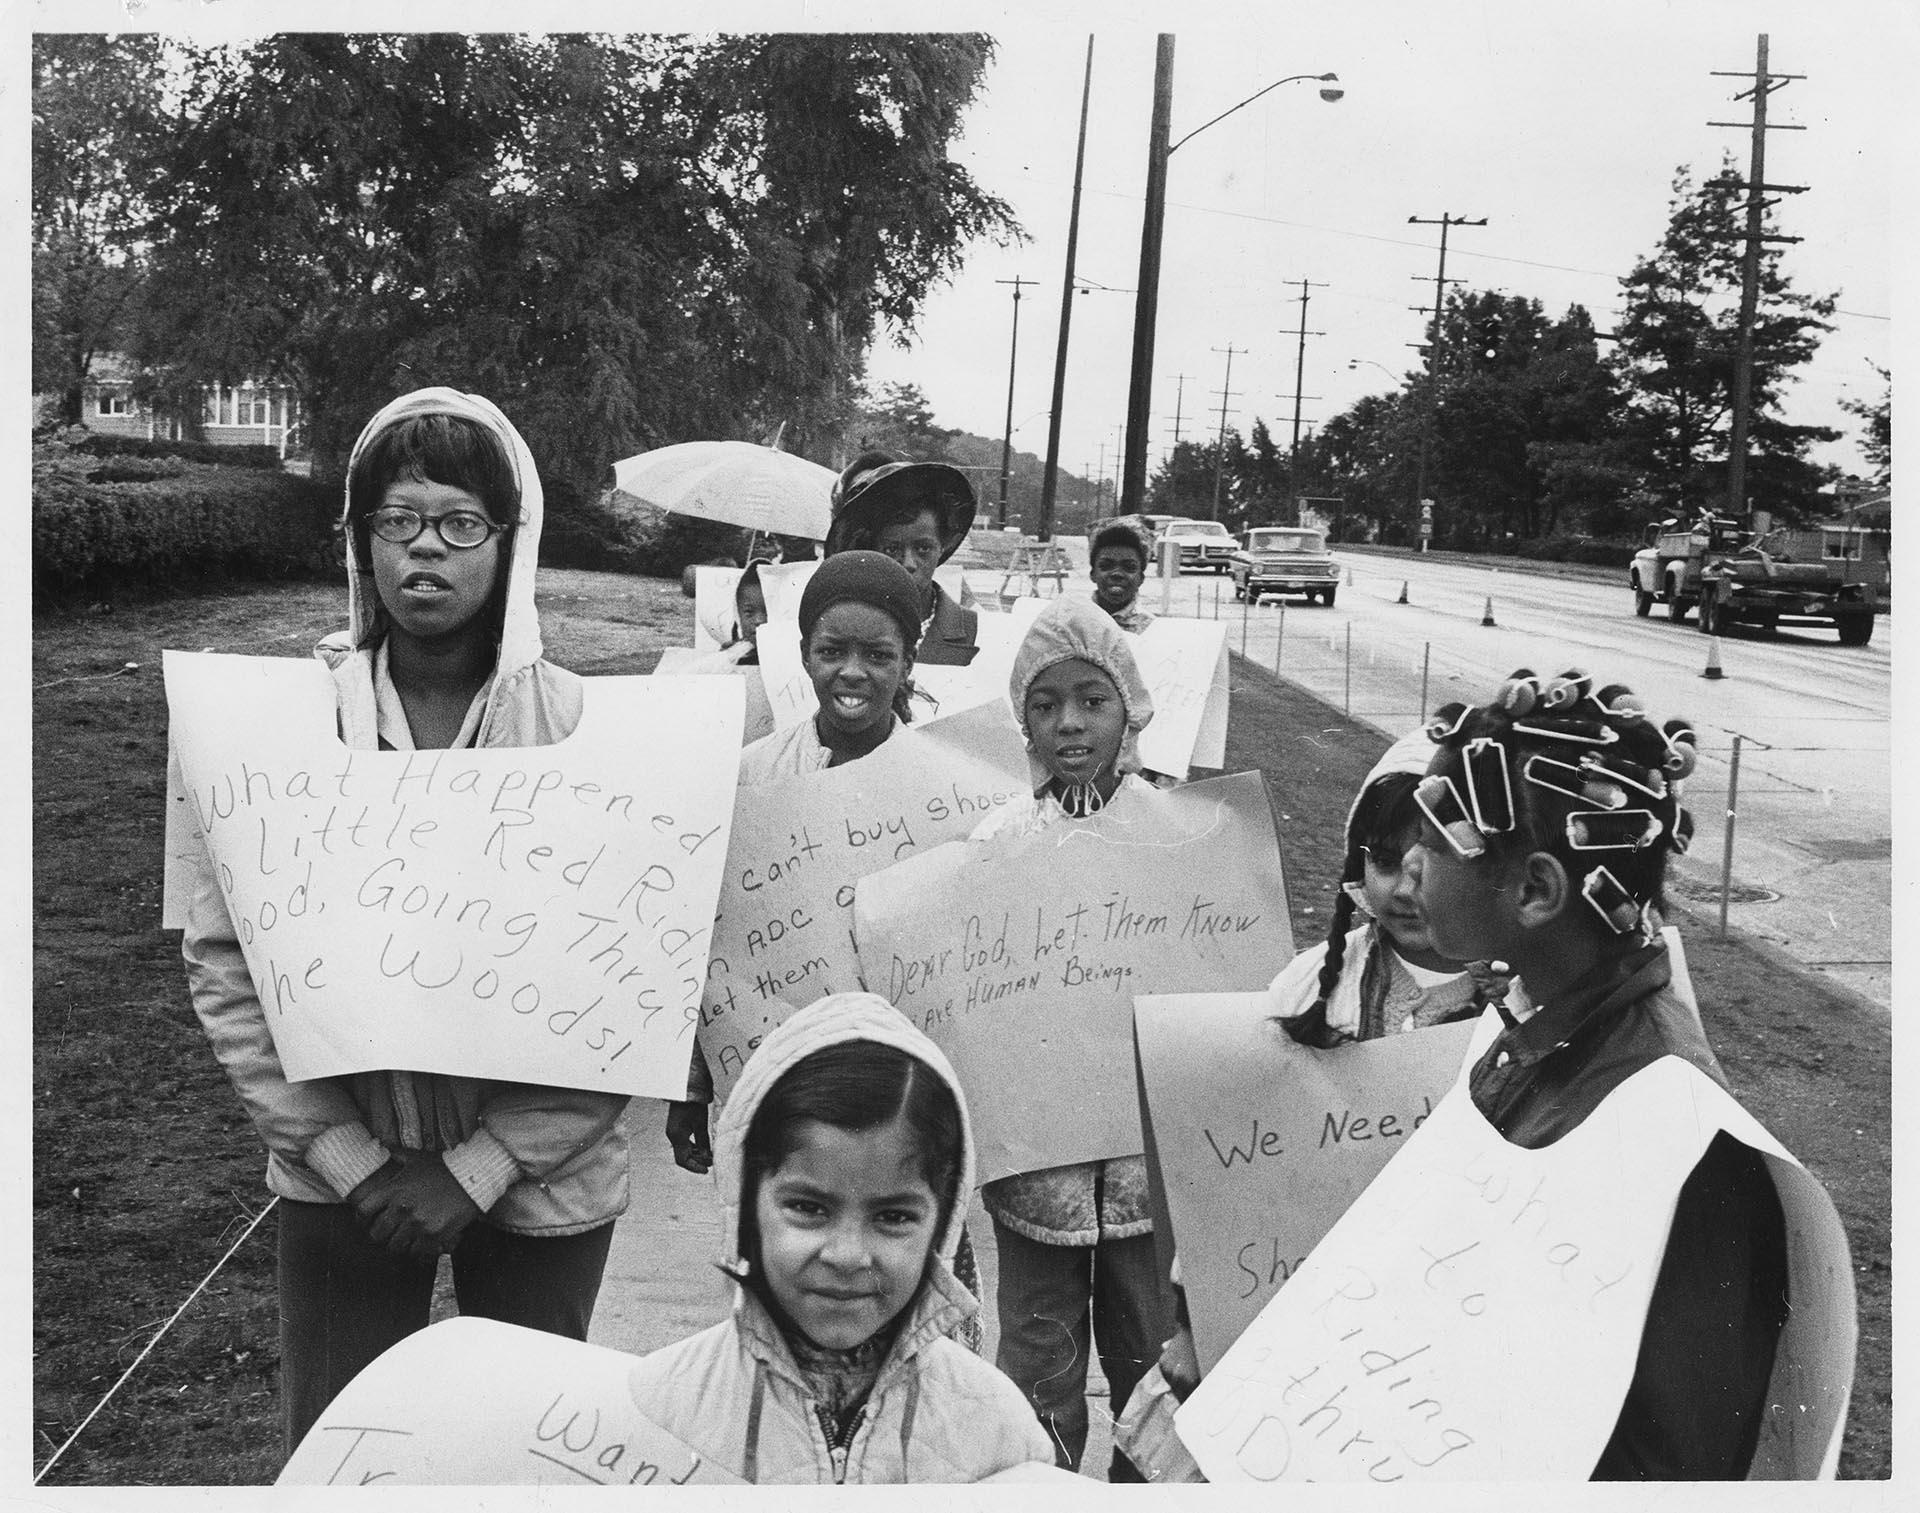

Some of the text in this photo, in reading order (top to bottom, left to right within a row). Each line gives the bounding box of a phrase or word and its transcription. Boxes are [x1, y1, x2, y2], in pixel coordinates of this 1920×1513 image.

[194, 752, 721, 856] What Happened
[846, 816, 915, 860] buy
[259, 804, 438, 875] Little
[485, 808, 605, 889] Red
[232, 860, 326, 946] ood,
[358, 858, 540, 958] Going
[963, 912, 1011, 972] God,
[1102, 896, 1168, 942] Them
[381, 934, 631, 1074] Woods!
[752, 956, 830, 1000] them
[1204, 1119, 1284, 1168] We
